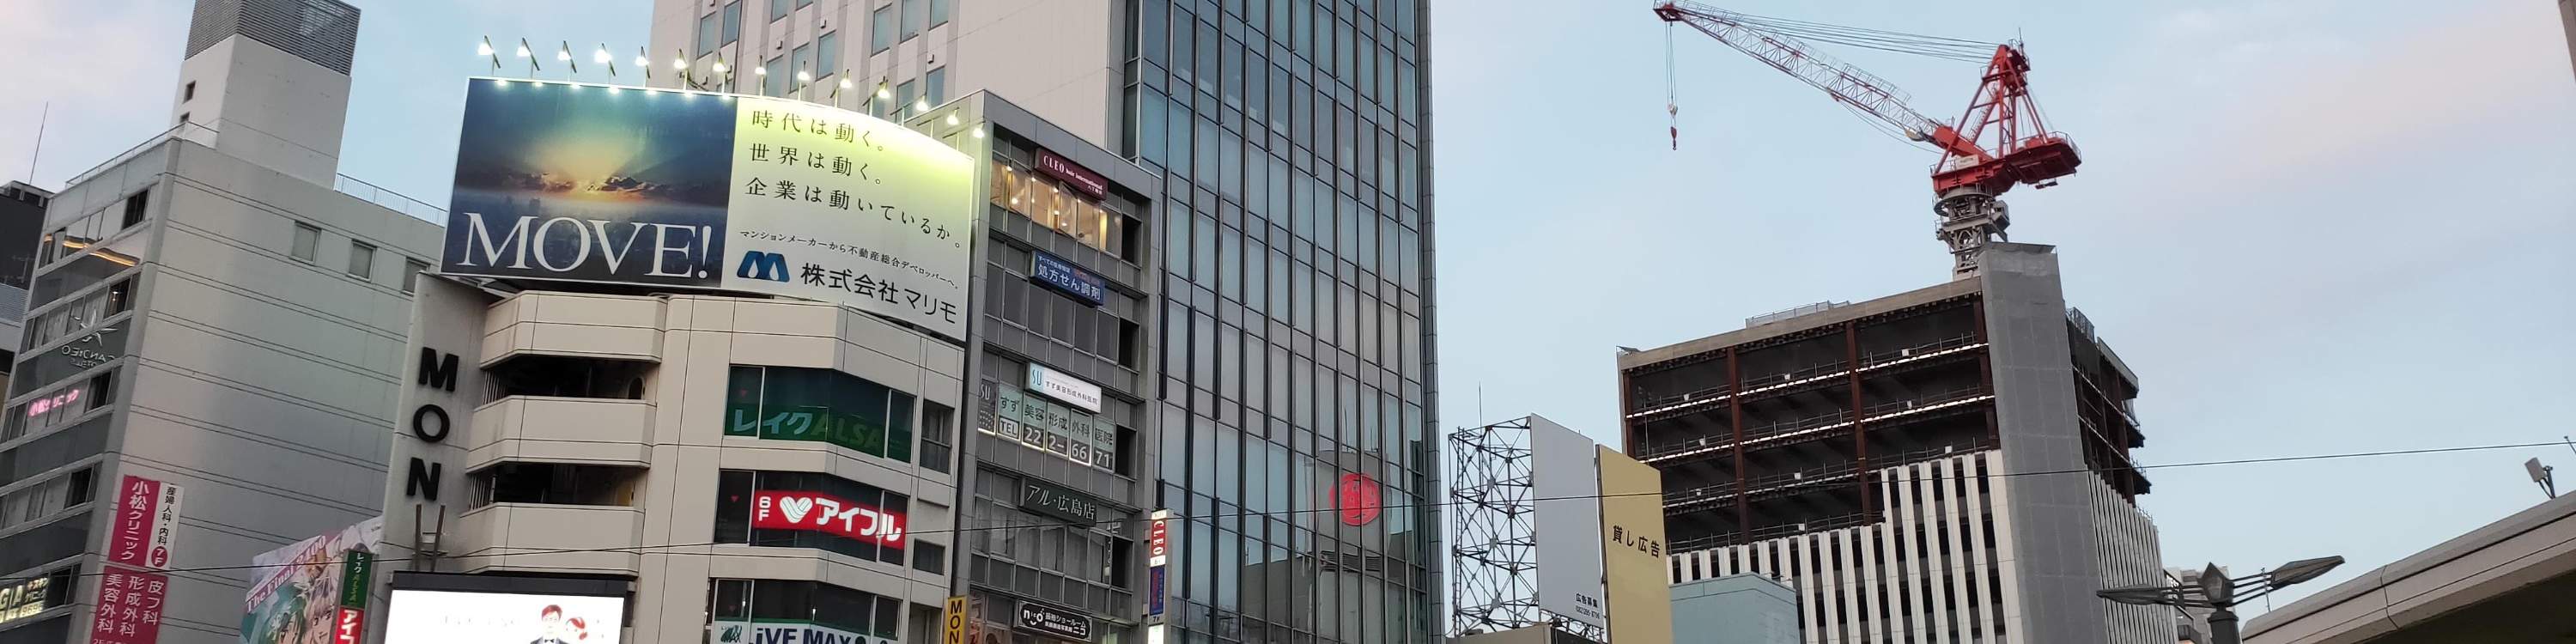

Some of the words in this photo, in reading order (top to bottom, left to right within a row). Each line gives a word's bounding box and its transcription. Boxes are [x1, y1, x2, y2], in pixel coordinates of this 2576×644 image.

[752, 110, 884, 152] 時代は動く。
[750, 143, 881, 185] 世界は動く。
[1043, 155, 1065, 173] CLEO
[745, 177, 961, 249] 企業は動いているか。
[455, 212, 712, 279] MOVE!
[739, 230, 959, 290] マンションメーカーから不動産総合デベロッパーへ。
[800, 262, 957, 324] 株式会社マリモ
[1038, 263, 1102, 301] 処方せん調剤
[981, 384, 991, 400] SU
[1031, 368, 1043, 386] SU
[406, 347, 459, 501] MON
[1000, 420, 1018, 435] TEL
[121, 480, 150, 561] 小松クリニック
[157, 486, 178, 546] 産婦人科・内科
[758, 496, 772, 522] 6F
[815, 497, 902, 542] アイフル
[1026, 484, 1097, 519] アル・広島店
[155, 547, 164, 566] 7F
[1152, 520, 1164, 555] CLEO
[1613, 525, 1661, 559] 貸し広告
[97, 574, 124, 634] 美容外科
[119, 575, 145, 637] 形成外科
[143, 580, 165, 625] 皮フ科
[247, 592, 265, 612] The
[268, 565, 294, 595] Final
[949, 599, 962, 644] MON
